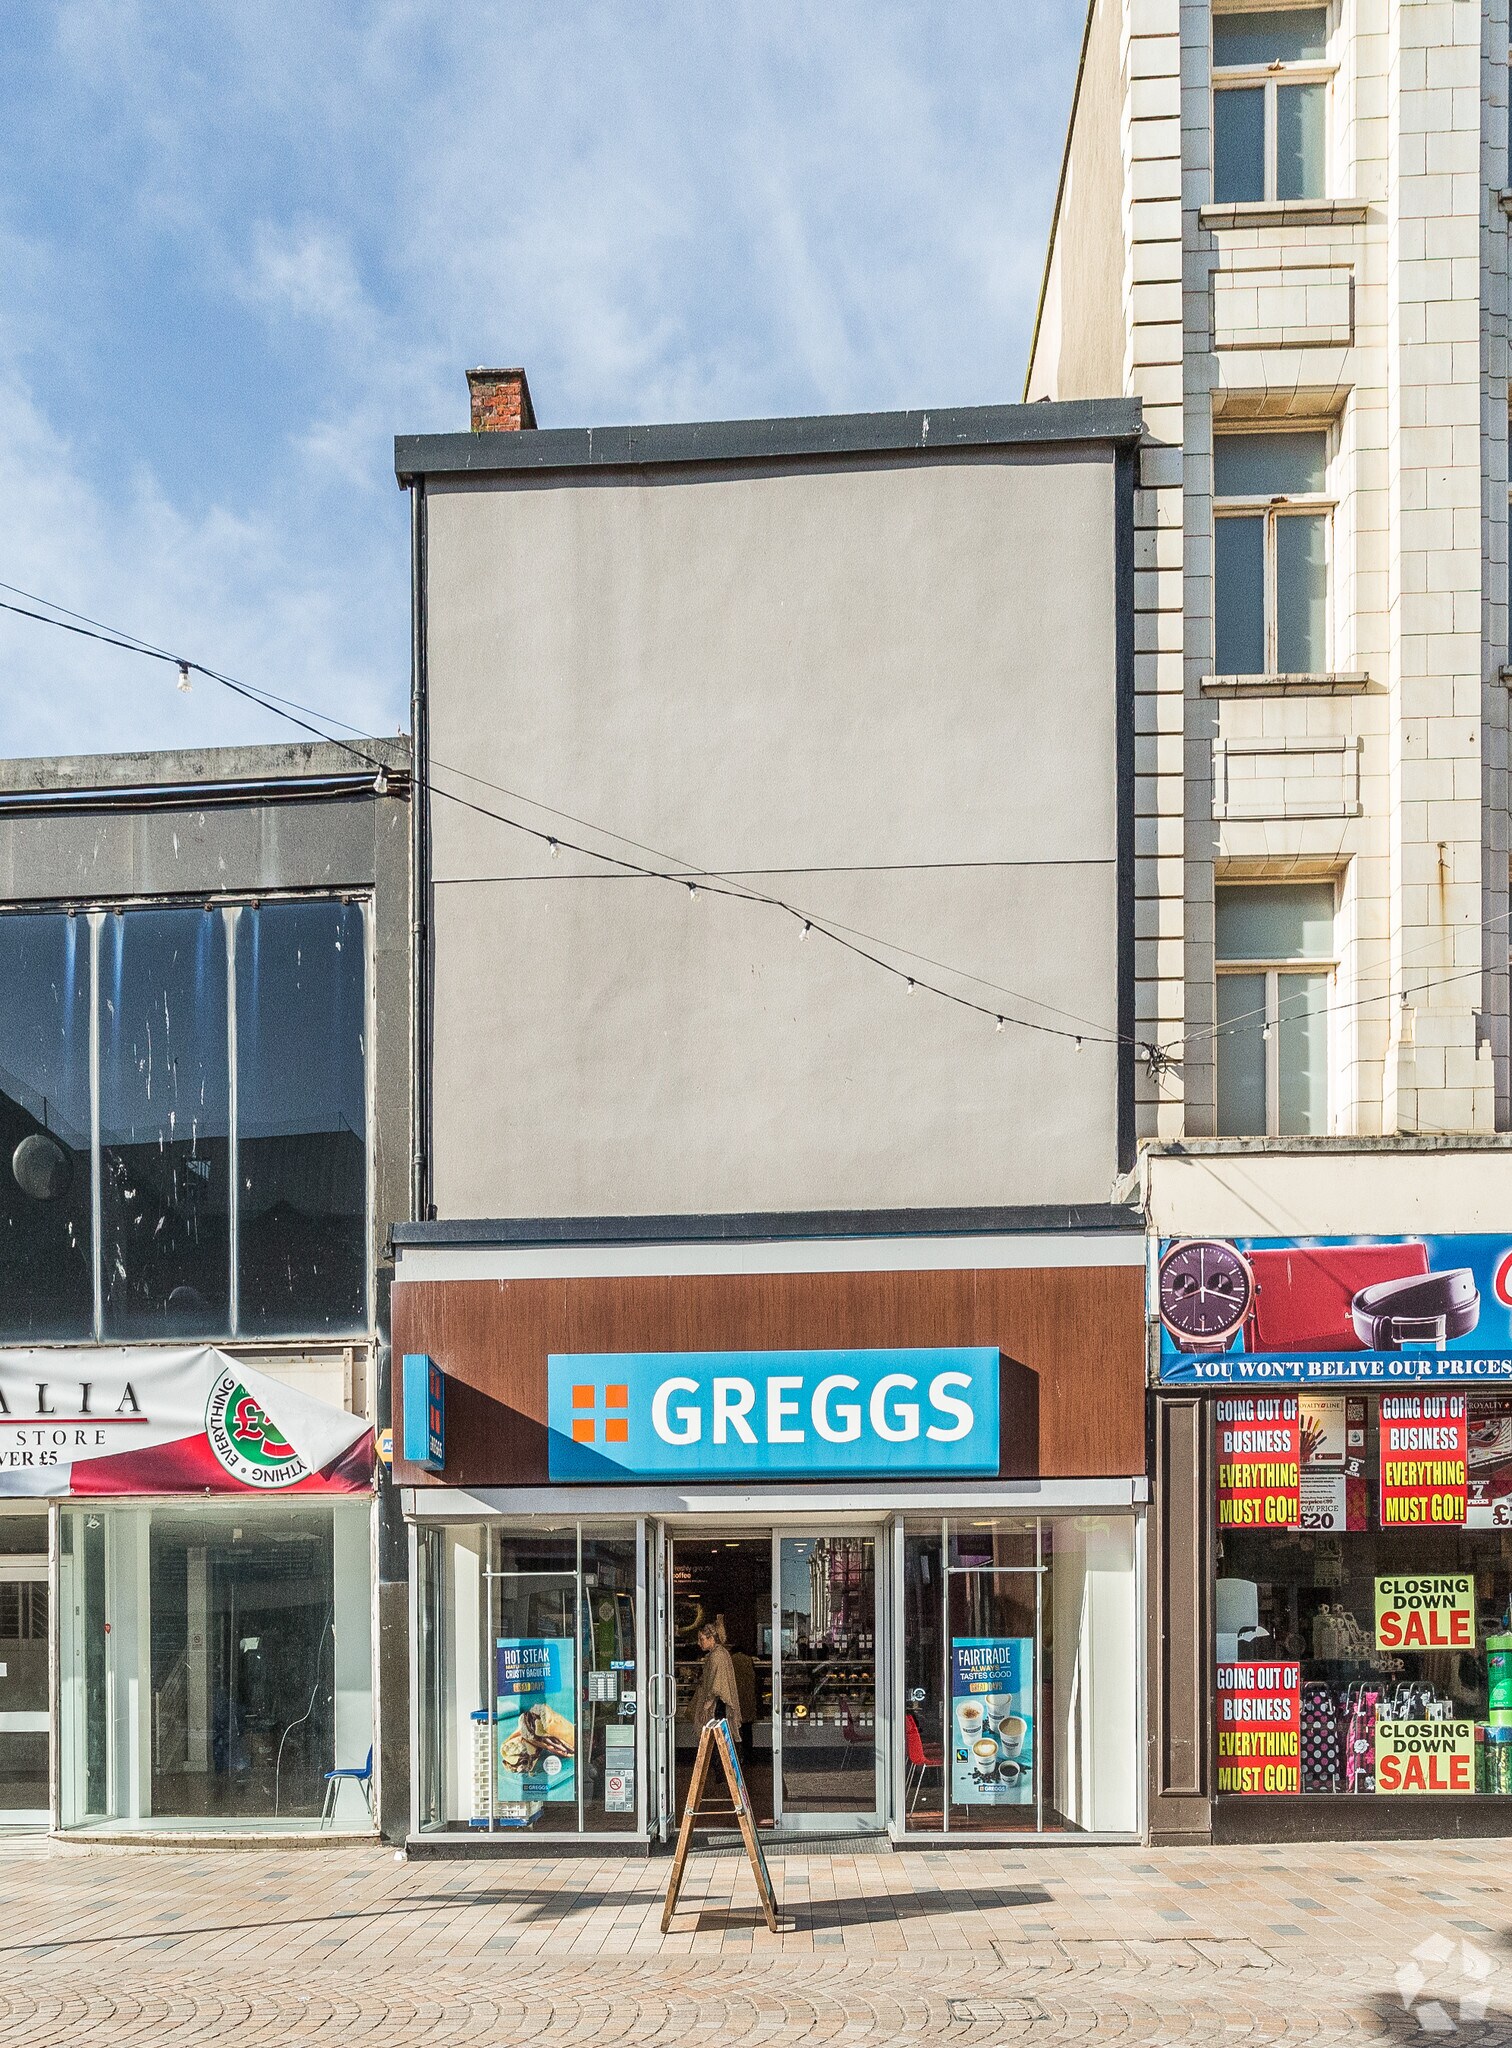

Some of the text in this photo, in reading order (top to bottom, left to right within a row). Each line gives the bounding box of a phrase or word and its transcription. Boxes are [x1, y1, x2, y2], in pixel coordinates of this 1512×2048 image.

[1193, 1359, 1512, 1377] YOU WON'T BELIVE OUR PRICES
[651, 1371, 975, 1446] GREGGS
[1217, 1398, 1298, 1421] GOING OUT OF
[1383, 1396, 1465, 1419] GOING OUT OF
[1469, 1401, 1503, 1409] ROYALTY
[210, 1377, 240, 1467] EVERYTHING
[16, 1430, 106, 1446] STORE
[1223, 1429, 1291, 1453] BUSINESS
[1390, 1427, 1459, 1451] BUSINESS
[0, 1450, 58, 1467] VER £5
[1349, 1461, 1360, 1472] 8
[252, 1460, 308, 1483] YTHING
[1219, 1462, 1298, 1488] EVERYTHING
[1385, 1460, 1465, 1486] EVERYTHING
[1472, 1485, 1484, 1498] 7
[1219, 1495, 1298, 1524] MUST GO!!
[1385, 1493, 1465, 1522] MUST GO!!
[1298, 1512, 1334, 1530] £20
[1380, 1579, 1469, 1595] CLOSING
[1393, 1594, 1456, 1610] DOWN
[1379, 1609, 1471, 1647] SALE
[504, 1647, 550, 1665] HOT STEAK
[958, 1646, 1011, 1667] FAIRTRADE
[505, 1666, 551, 1679] CRUSTY BAGUETTE
[960, 1670, 1012, 1681] TASTES GOOD
[970, 1664, 1000, 1672] ALWAYS
[1217, 1666, 1298, 1690] GOING OUT OF
[1223, 1697, 1291, 1721] BUSINESS
[1380, 1723, 1470, 1739] CLOSING
[1218, 1731, 1298, 1756] EVERYTHING
[1393, 1739, 1456, 1753] DOWN
[1218, 1763, 1298, 1792] MUST GO!!
[1379, 1754, 1471, 1791] SALE
